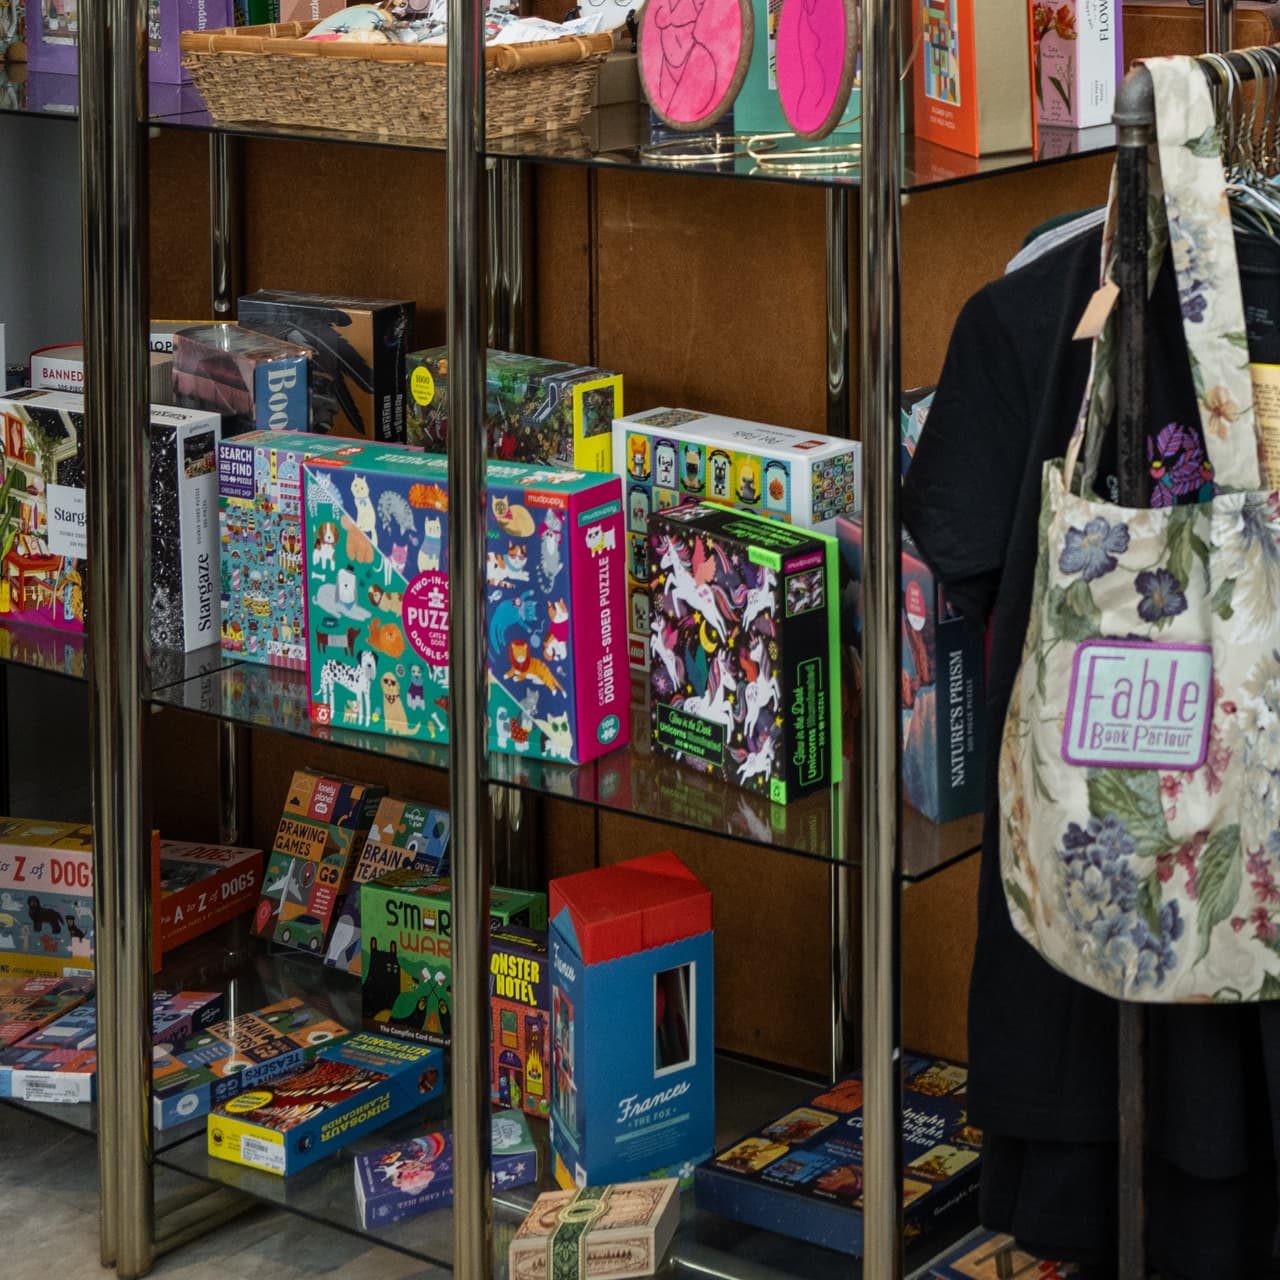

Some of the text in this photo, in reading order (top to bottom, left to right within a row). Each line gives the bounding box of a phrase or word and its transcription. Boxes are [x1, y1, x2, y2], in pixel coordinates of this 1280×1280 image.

[42, 368, 84, 382] BANNED
[220, 446, 253, 460] SEARCH
[198, 553, 212, 632] Stargaze
[949, 649, 963, 704] PRISM
[1078, 655, 1200, 749] Fable
[951, 706, 965, 788] NATURE'S
[1090, 721, 1193, 751] Book Parlour
[279, 820, 325, 842] DRAWING
[276, 837, 311, 857] GAMES
[362, 844, 401, 865] BRAIN
[221, 870, 255, 898] DOGS
[497, 974, 537, 1006] HOTEL
[617, 1081, 691, 1123] Frances
